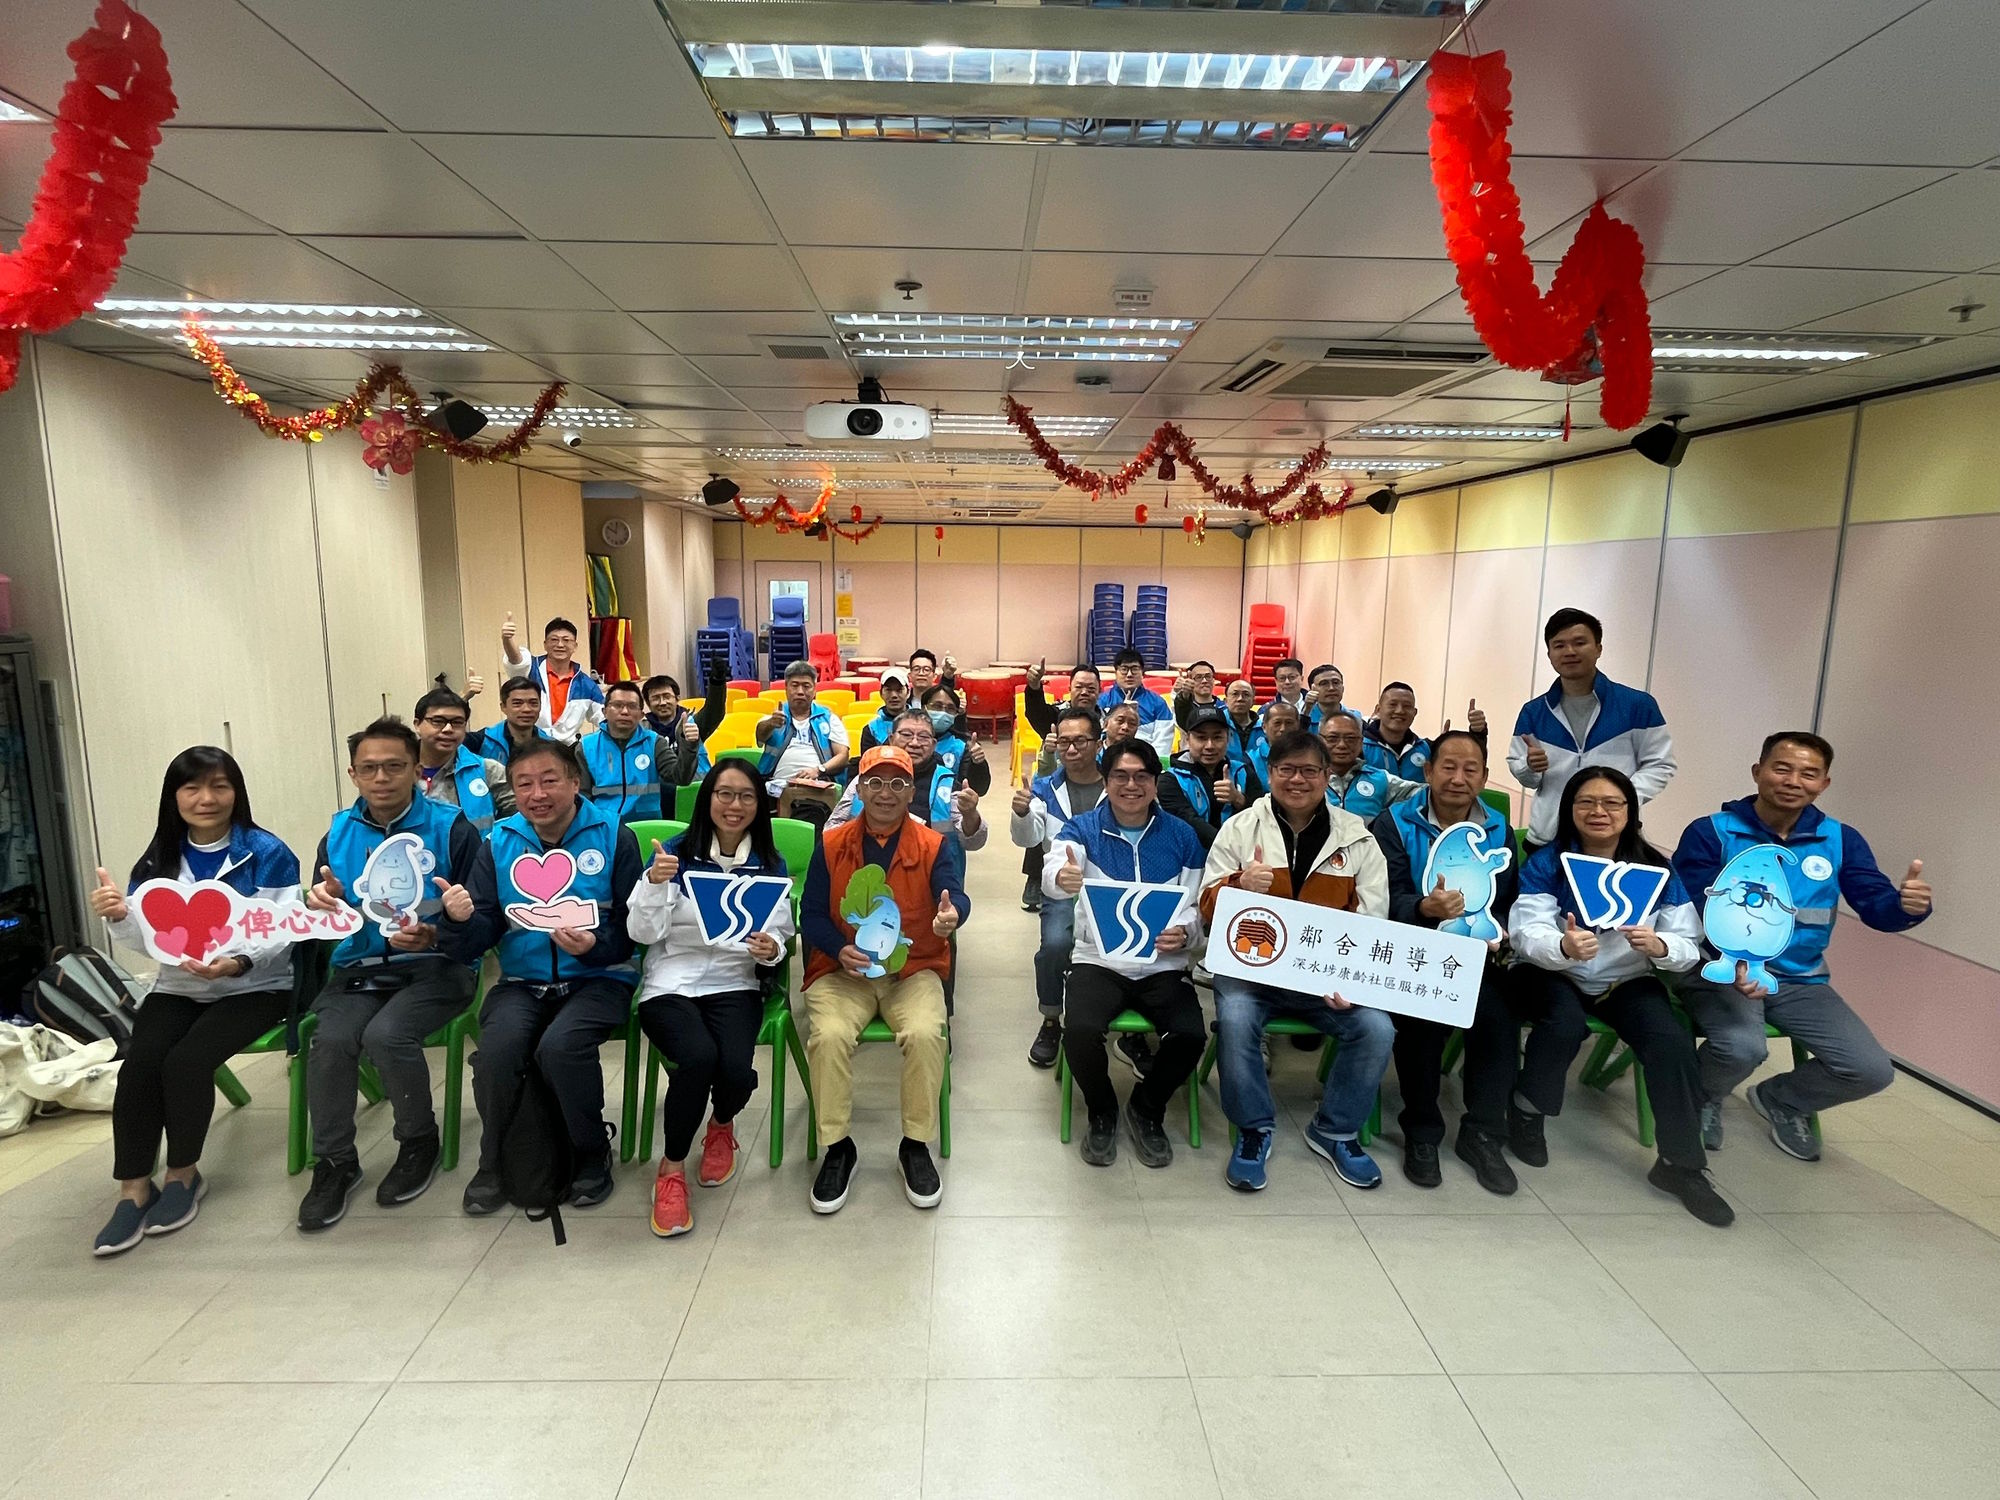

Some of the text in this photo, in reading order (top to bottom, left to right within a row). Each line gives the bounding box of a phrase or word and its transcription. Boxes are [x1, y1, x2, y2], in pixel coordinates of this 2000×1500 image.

[237, 907, 357, 940] 俾心心
[1299, 924, 1463, 980] 鄰舍輔導會
